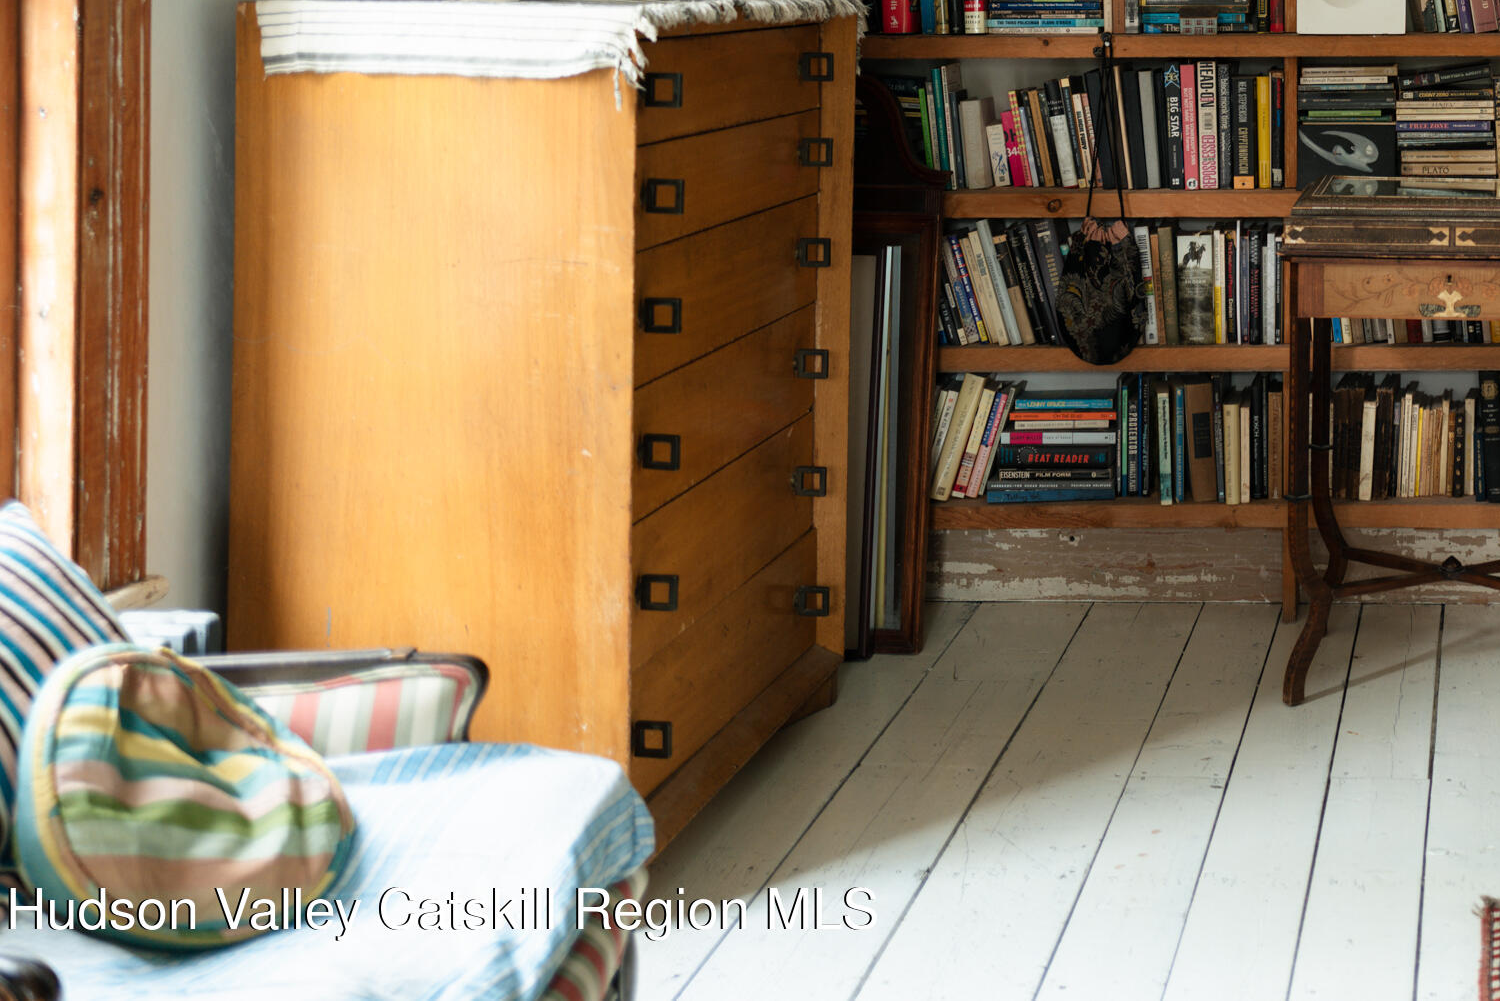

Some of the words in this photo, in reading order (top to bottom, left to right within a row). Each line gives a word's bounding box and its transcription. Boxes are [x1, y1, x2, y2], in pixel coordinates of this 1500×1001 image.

[1220, 78, 1228, 96] black
[1238, 81, 1247, 93] NEAL
[1170, 97, 1178, 114] BIG
[1238, 94, 1247, 123] STEPHENSON
[1171, 116, 1179, 137] STAR
[1079, 133, 1088, 150] FURY
[1238, 127, 1248, 174] CRYPTONOMICON
[1252, 415, 1260, 437] BOSCH
[1028, 454, 1051, 463] BEAT
[1054, 455, 1090, 463] READER
